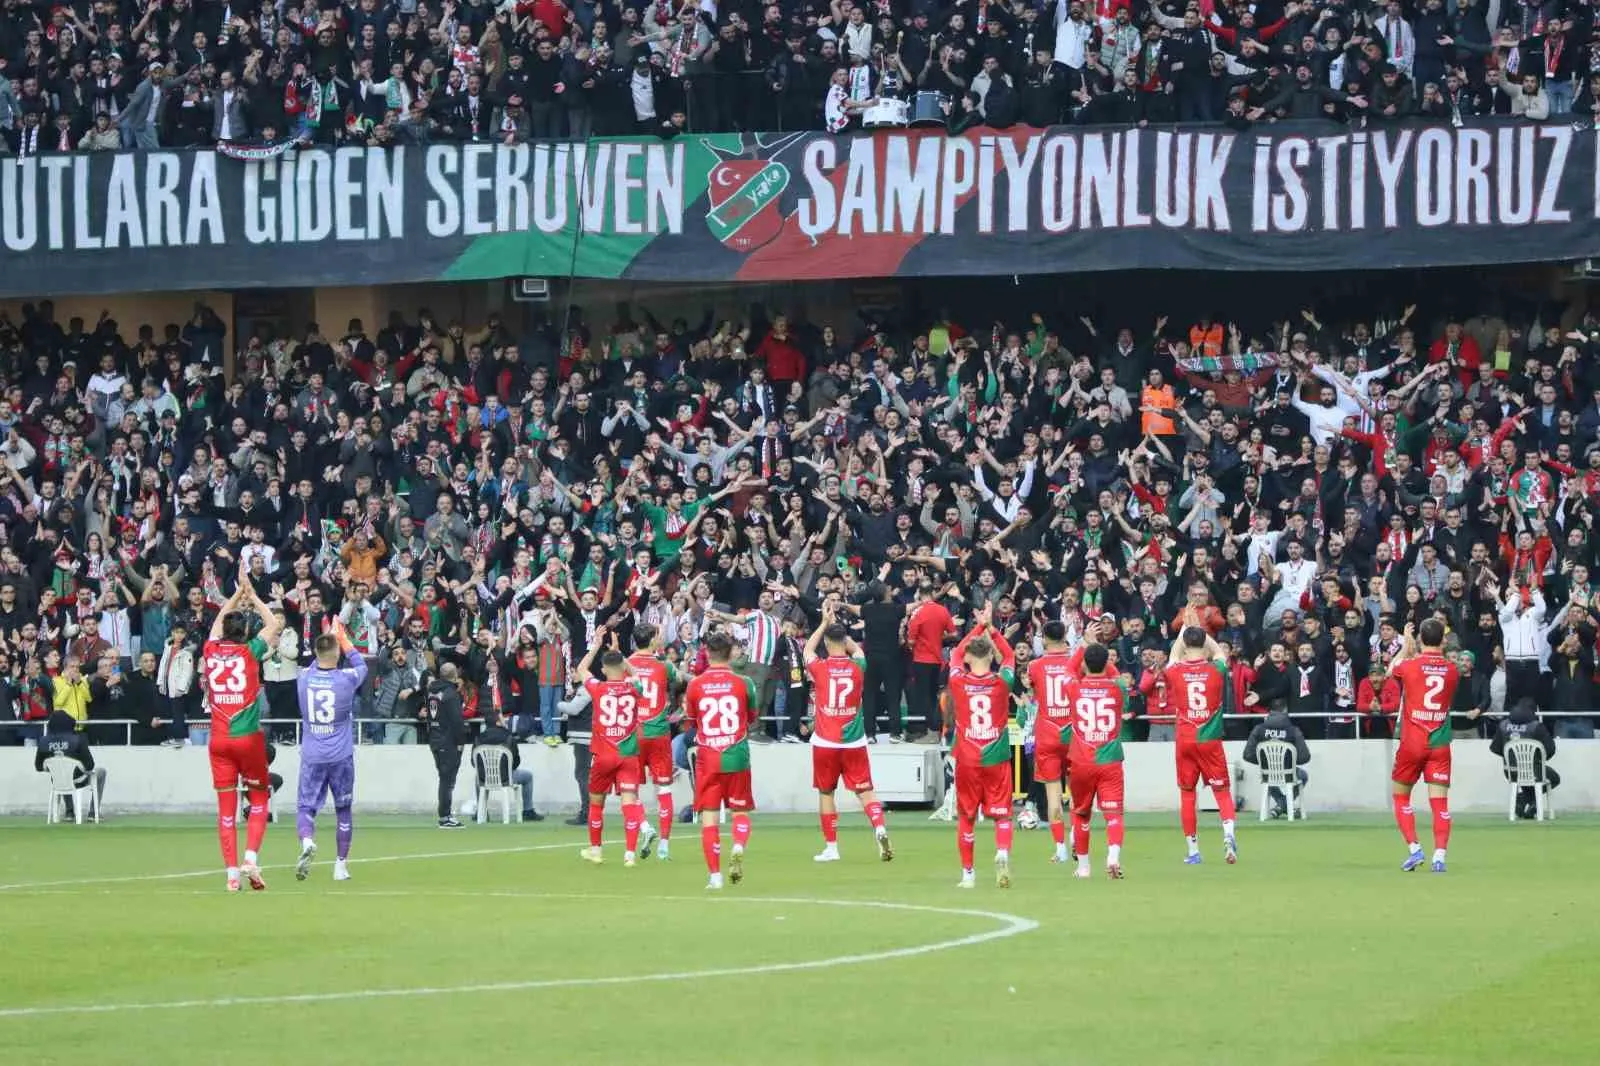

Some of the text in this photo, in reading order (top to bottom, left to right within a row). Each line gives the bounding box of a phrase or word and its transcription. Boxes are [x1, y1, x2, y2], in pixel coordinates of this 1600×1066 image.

[1252, 126, 1573, 232] İSTİYORUZ
[207, 656, 248, 693] 23
[1423, 674, 1445, 711] 2
[306, 687, 337, 724] 13
[599, 694, 636, 727] 93
[968, 693, 993, 730] 8
[1186, 681, 1208, 711] 6
[698, 695, 740, 737] 28
[1075, 697, 1117, 733] 95
